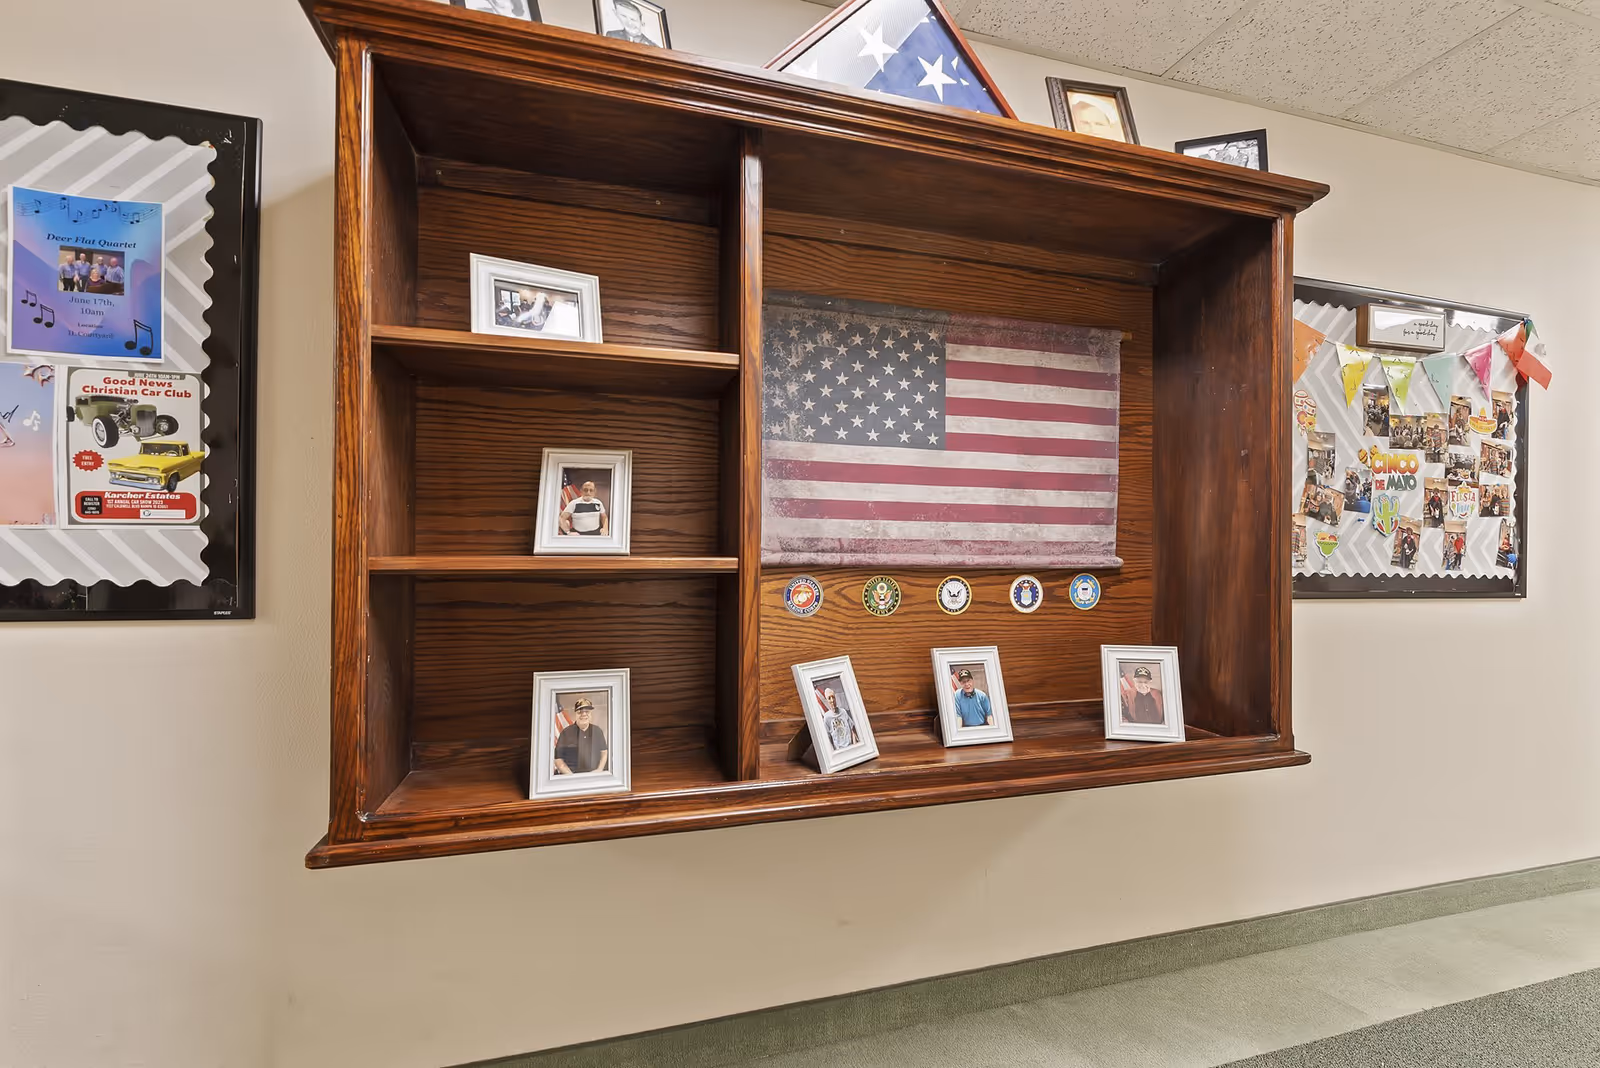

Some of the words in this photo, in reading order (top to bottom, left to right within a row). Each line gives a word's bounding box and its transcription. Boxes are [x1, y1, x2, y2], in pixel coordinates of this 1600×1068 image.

[46, 232, 72, 242] Deer
[75, 236, 95, 245] Flat
[98, 238, 136, 248] Quartet
[69, 296, 90, 305] June
[80, 308, 104, 316] 10am
[103, 376, 136, 386] Good
[139, 379, 172, 388] News
[82, 386, 138, 396] Christian
[141, 388, 162, 396] Car
[164, 390, 192, 398] Club
[1372, 454, 1419, 474] CINCO
[1376, 480, 1386, 490] DE
[1386, 474, 1417, 491] MAYO
[1451, 490, 1476, 502] FIESTA
